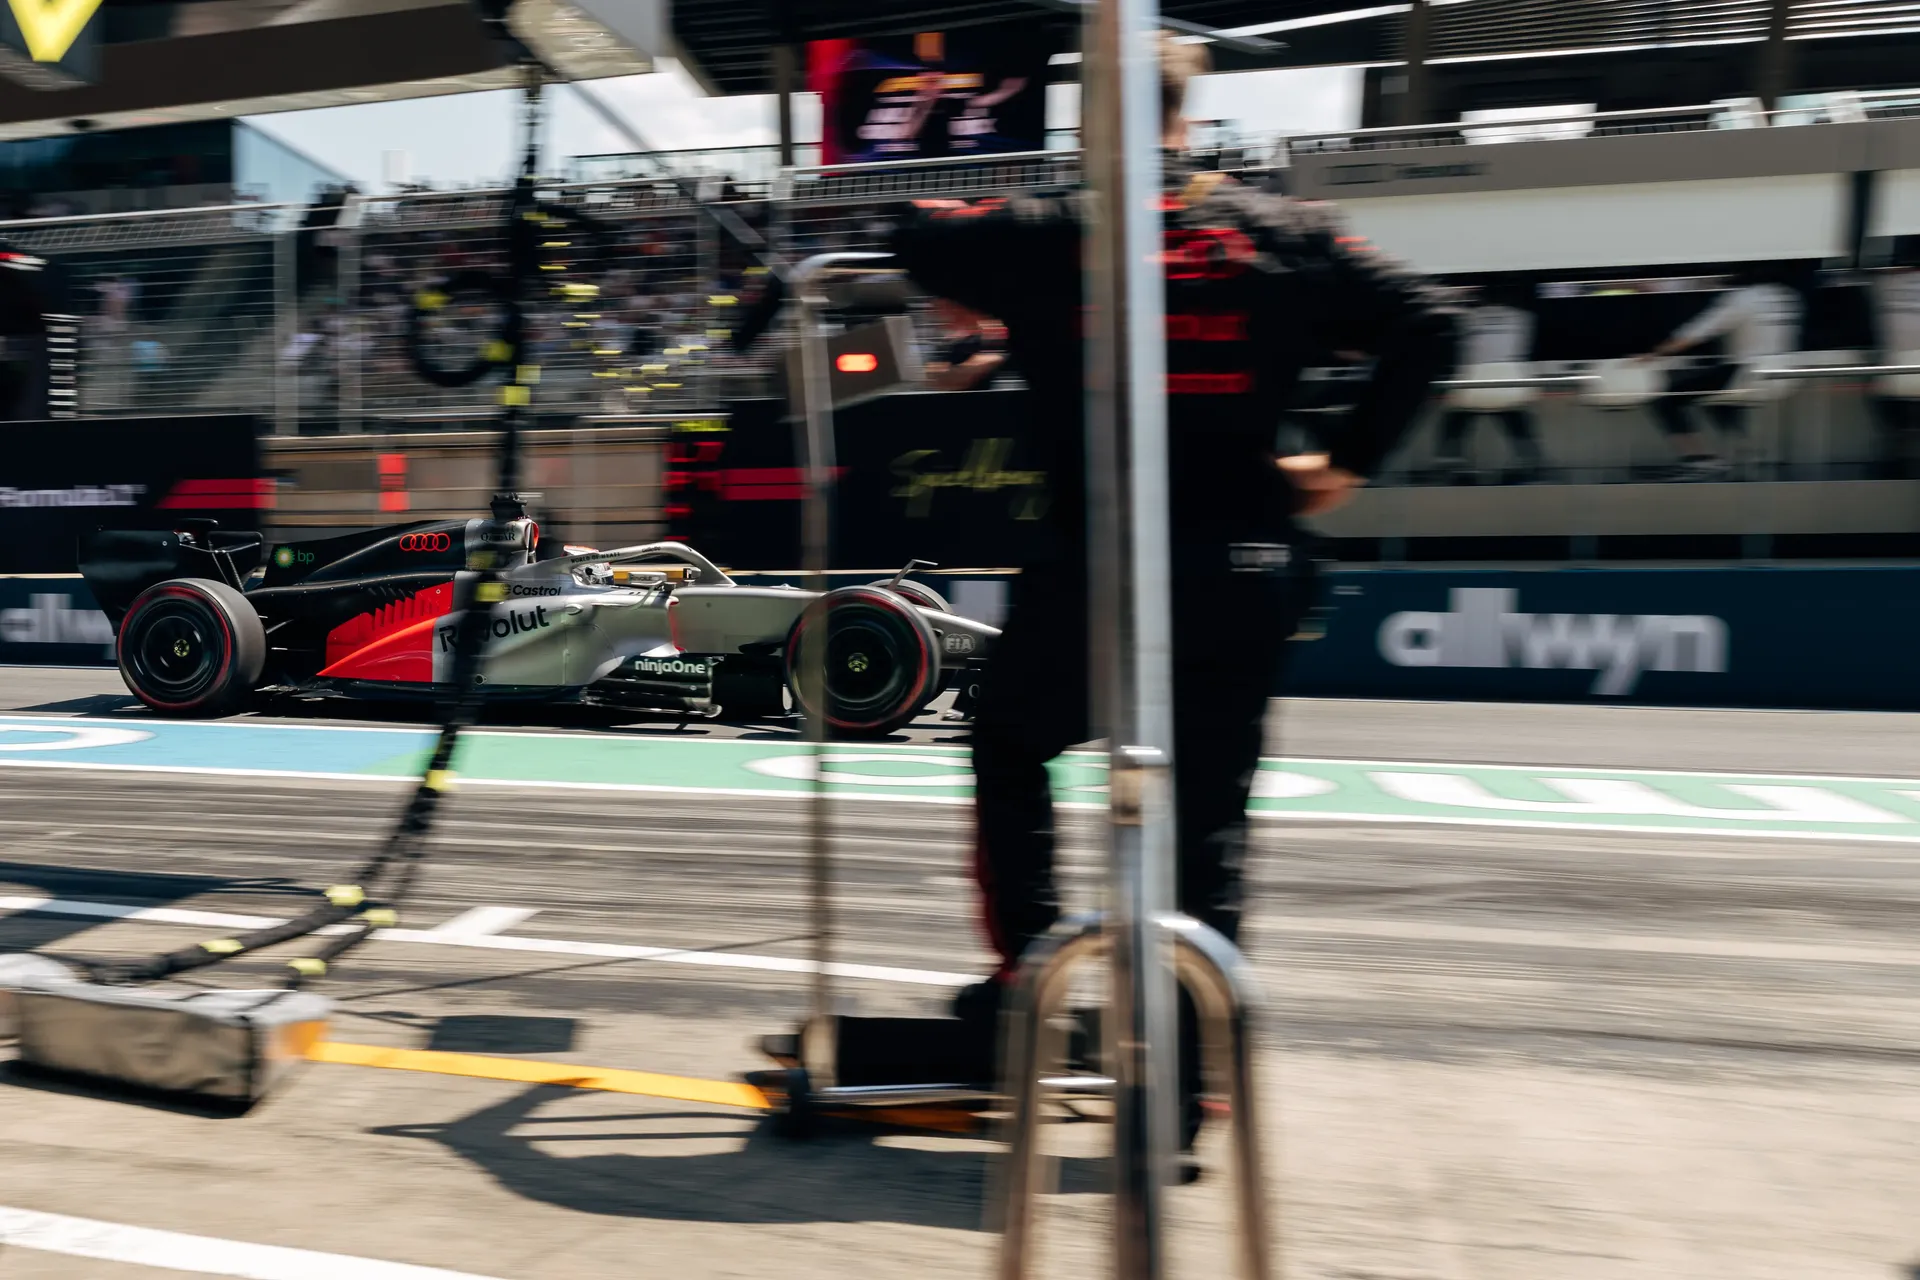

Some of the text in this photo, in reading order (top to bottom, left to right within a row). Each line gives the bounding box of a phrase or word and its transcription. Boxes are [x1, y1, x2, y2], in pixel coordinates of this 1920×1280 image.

[481, 532, 515, 541] QAR
[297, 549, 315, 565] bp
[512, 585, 562, 596] Castrol
[439, 605, 550, 652] Rolut
[1377, 588, 1729, 695] allwyn
[635, 659, 706, 675] ninjaOne
